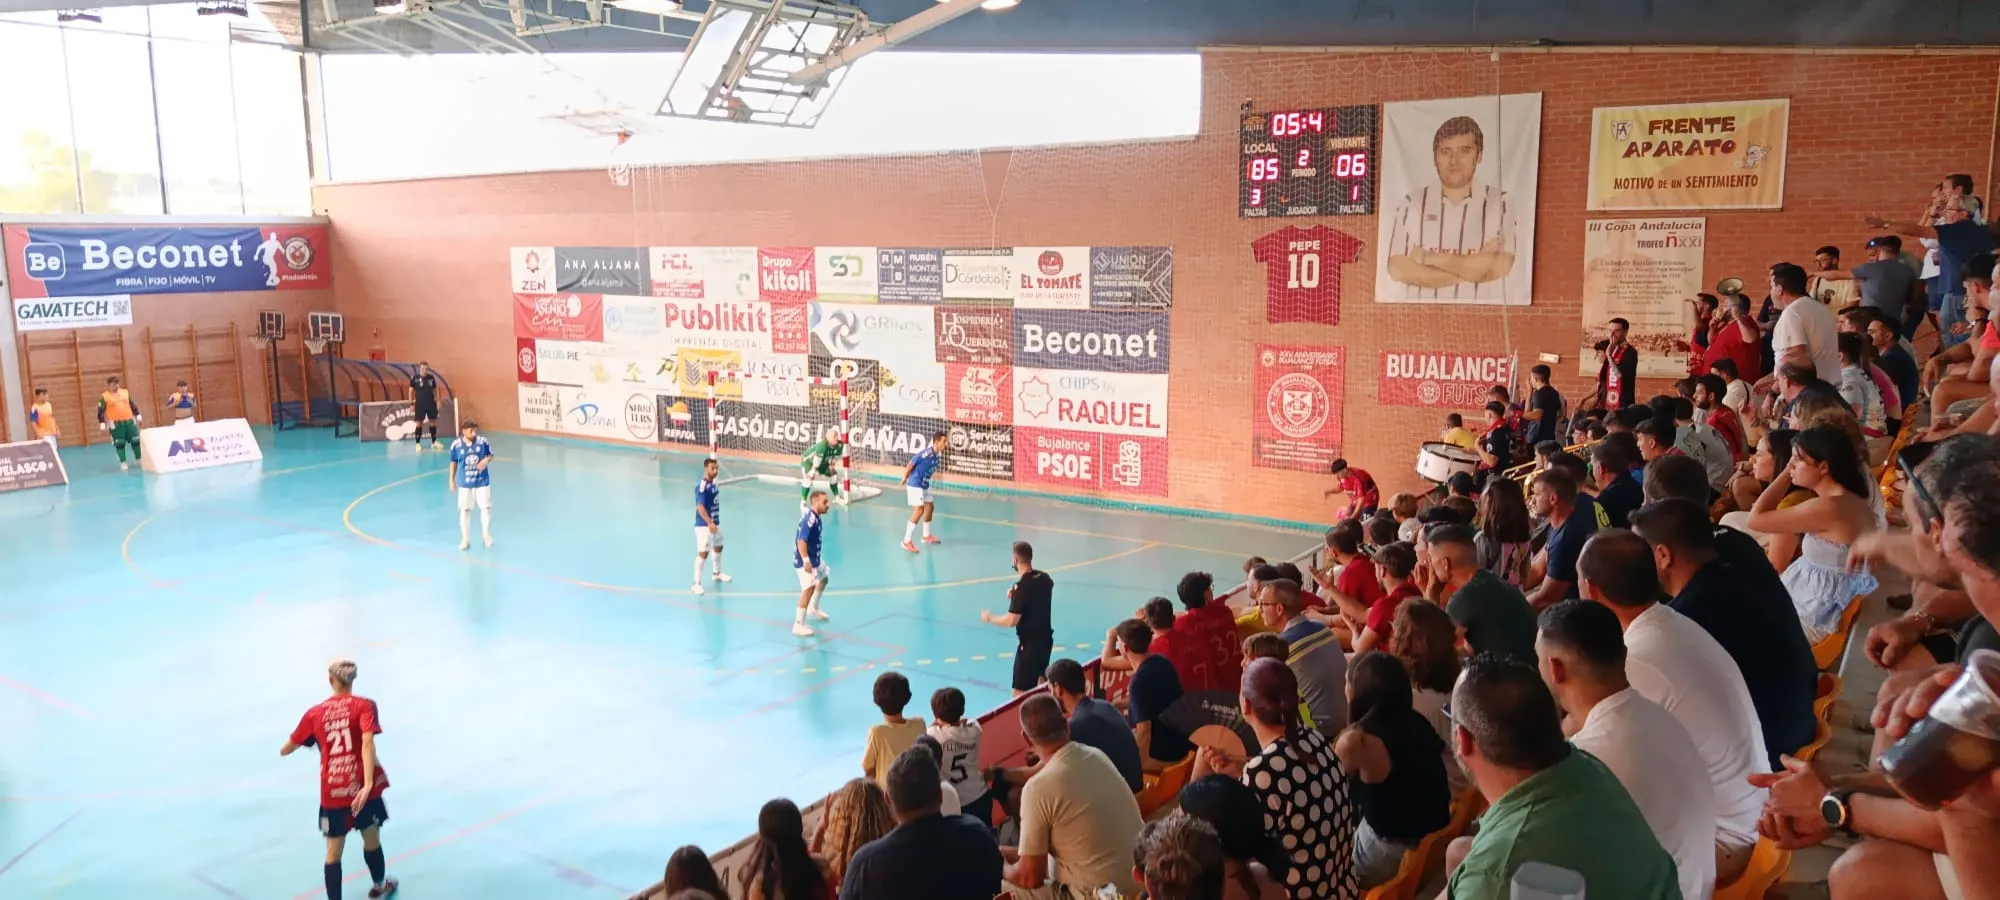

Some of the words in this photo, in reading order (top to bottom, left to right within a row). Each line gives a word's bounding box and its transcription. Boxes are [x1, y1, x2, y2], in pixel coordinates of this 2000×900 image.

[1648, 116, 1736, 136] FRENTE
[1245, 143, 1278, 153] LOCAL
[1331, 136, 1366, 147] VISITANTE
[1622, 138, 1737, 159] APARATO
[1298, 149, 1310, 166] 2
[1291, 167, 1316, 177] PERIODO
[1613, 175, 1654, 190] MOTIVO
[1658, 179, 1668, 190] DE
[1671, 179, 1682, 189] UN
[1685, 173, 1758, 189] SENTIMIENTO
[1251, 188, 1261, 204] 3
[1352, 185, 1358, 200] 1
[1244, 207, 1267, 216] FALTAS
[1286, 206, 1317, 215] JUGADOR
[1339, 204, 1365, 213] FALTAS
[1588, 222, 1601, 232] III
[1605, 221, 1636, 233] Copa
[1289, 240, 1321, 251] PEPE
[1637, 239, 1664, 249] TROFEO
[28, 252, 60, 271] Be
[80, 238, 243, 271] Beconet
[762, 255, 792, 268] Grupo
[894, 254, 903, 264] M
[909, 253, 936, 262] RUBÉN
[564, 259, 587, 270] ANA
[593, 259, 640, 271] ALJAMA
[1287, 253, 1320, 289] 10
[116, 276, 143, 287] FIBRA
[148, 275, 168, 286] FIJO
[173, 274, 200, 285] MÓVIL
[205, 274, 216, 284] TV
[521, 281, 546, 291] ZEN
[762, 269, 811, 292] kitoli
[909, 275, 940, 283] BLANCO
[1020, 272, 1034, 289] EL
[1036, 272, 1082, 289] TOMATE
[17, 300, 108, 320] GAVATECH
[665, 302, 767, 334] Publikit
[1023, 324, 1158, 358] Beconet
[538, 347, 565, 360] SALUD
[566, 351, 580, 361] PIE
[1387, 353, 1508, 382] BUJALANCE
[1059, 376, 1099, 391] CHIPS
[1442, 382, 1490, 406] FUTS
[1058, 398, 1161, 429] RAQUEL
[664, 427, 696, 440] REPSOL
[715, 412, 812, 444] GASÓLEOS
[969, 428, 1010, 442] Servicios
[1037, 435, 1091, 452] Bujalance
[1037, 452, 1092, 480] PSOE
[1211, 630, 1242, 666] 32
[326, 728, 353, 756] 21
[949, 753, 969, 784] 5
